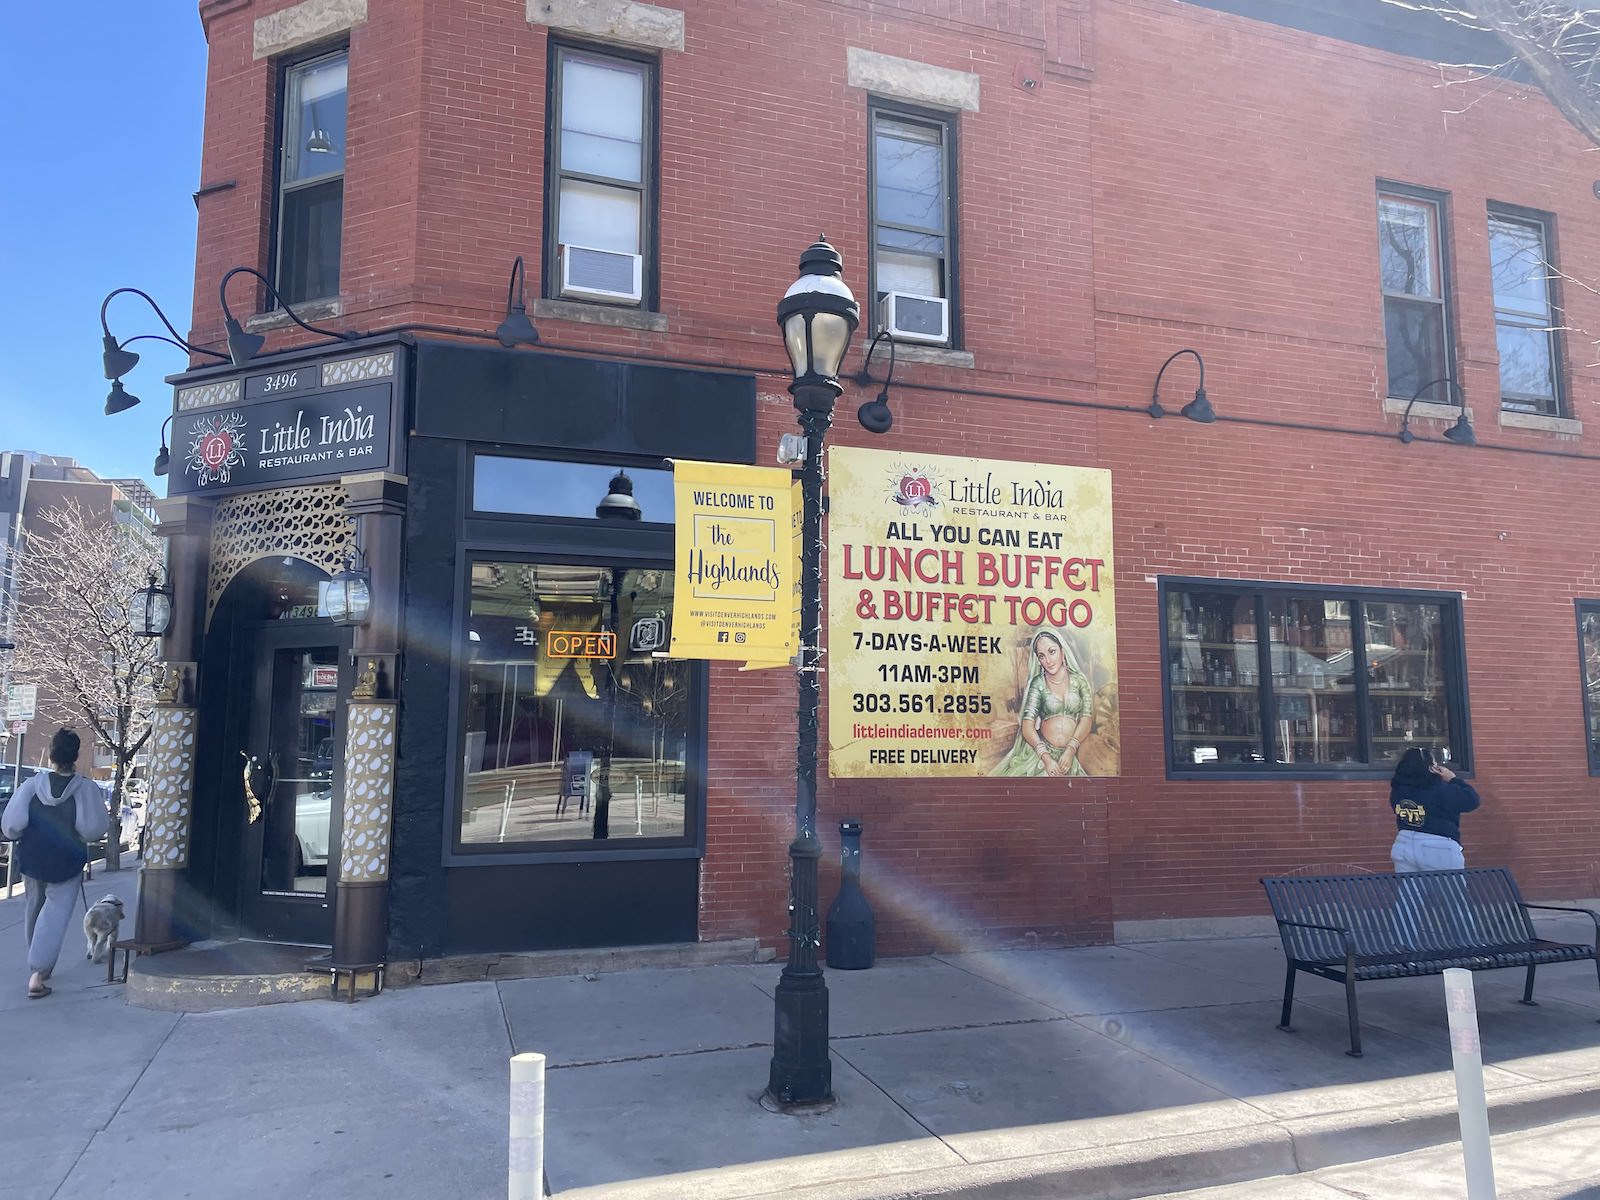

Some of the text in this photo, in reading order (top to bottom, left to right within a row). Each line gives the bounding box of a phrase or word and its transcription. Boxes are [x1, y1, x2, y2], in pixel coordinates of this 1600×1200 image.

[264, 372, 298, 391] 3496
[259, 405, 375, 455] Little India
[259, 445, 373, 469] RESTAURANT & BAR
[693, 491, 774, 510] WELCOME TO
[948, 472, 1065, 509] Little India
[953, 507, 1068, 522] RESTAURANT & BAR
[706, 524, 734, 546] the
[886, 521, 1063, 550] ALL YOU CAN EAT
[687, 548, 781, 591] Highlands
[842, 543, 1105, 592] LUNCH BUFFET
[856, 589, 1093, 628] & BUFFET TOGO
[700, 620, 766, 629] @VISITDENVERHIGHLANDS
[553, 636, 611, 655] OPEN
[852, 632, 1002, 655] 7-DAYS-A-WEEK
[878, 664, 980, 684] 11AM-3PM
[852, 693, 992, 714] 303.561.2855
[852, 722, 993, 739] littleindiadenver.com
[869, 748, 978, 765] FREE DELIVERY
